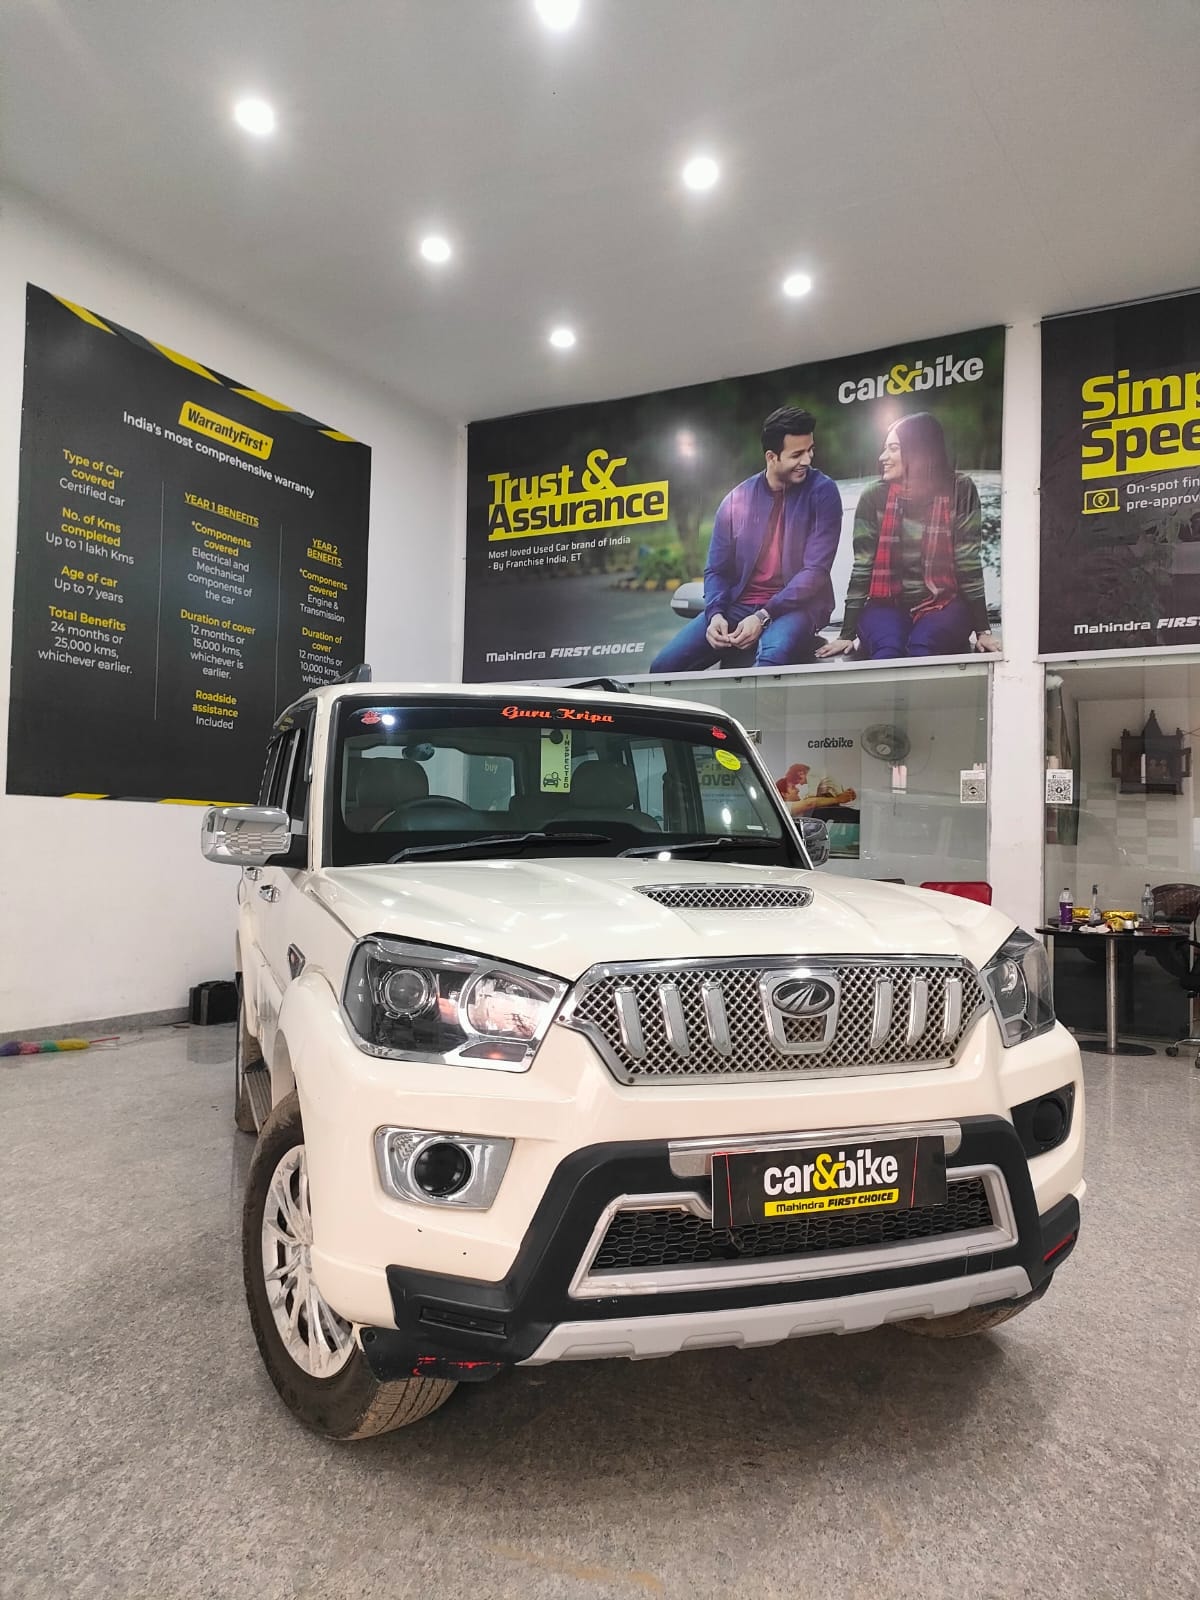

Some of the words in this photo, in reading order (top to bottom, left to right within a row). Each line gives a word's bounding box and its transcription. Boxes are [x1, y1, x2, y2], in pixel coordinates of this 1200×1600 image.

[838, 355, 984, 404] car&bike
[63, 449, 90, 468] Type
[92, 461, 105, 472] of
[105, 464, 125, 479] Car
[123, 411, 162, 436] India's
[164, 429, 193, 449] most
[195, 442, 273, 481] comprehensive
[274, 474, 315, 499] warranty
[71, 468, 115, 490] covered
[488, 465, 574, 505] Trust
[581, 448, 628, 491] &
[1127, 479, 1179, 495] On-spot
[59, 477, 107, 501] Certified
[109, 495, 126, 507] car
[62, 506, 81, 522] No.
[83, 515, 96, 526] of
[97, 518, 121, 533] Kms
[184, 492, 210, 510] YEAR
[217, 504, 260, 528] BENEFITS
[489, 490, 665, 535] Assurance
[61, 523, 121, 547] completed
[45, 531, 63, 547] Up
[65, 538, 77, 549] to
[85, 542, 108, 558] lakh
[111, 550, 135, 565] Kms
[203, 540, 239, 557] covered
[312, 538, 332, 553] YEAR
[333, 545, 338, 555] 2
[488, 550, 508, 560] Most
[510, 547, 532, 557] loved
[533, 544, 554, 554] Used
[555, 543, 569, 552] Car
[571, 539, 596, 550] brand
[598, 537, 608, 547] of
[609, 536, 631, 546] India
[192, 547, 232, 567] Electrical
[233, 560, 250, 573] and
[307, 547, 343, 568] BENEFITS
[493, 561, 504, 571] By
[506, 556, 544, 569] Franchise
[546, 554, 569, 564] India,
[571, 553, 582, 562] ET
[61, 565, 85, 580] Age
[86, 572, 100, 584] of
[100, 577, 118, 588] car
[196, 561, 245, 583] Mechanical
[54, 577, 71, 593] Up
[73, 583, 85, 594] to
[86, 585, 95, 596] 7
[95, 589, 124, 604] years
[187, 573, 242, 595] components
[243, 588, 253, 598] of
[308, 584, 337, 599] covered
[205, 590, 220, 602] the
[221, 595, 235, 605] car
[307, 594, 333, 609] Engine
[333, 601, 339, 610] &
[48, 605, 77, 621] Total
[79, 612, 127, 632] Benefits
[180, 608, 220, 627] Duration
[221, 620, 231, 630] of
[232, 623, 256, 635] cover
[299, 603, 345, 623] Transmission
[50, 621, 65, 634] 24
[67, 626, 110, 642] months
[112, 635, 124, 645] or
[190, 624, 199, 635] 12
[201, 628, 234, 643] months
[236, 636, 245, 645] or
[302, 627, 334, 642] Duration
[335, 636, 343, 644] of
[1074, 621, 1151, 635] Mahindra
[54, 636, 92, 653] 25,000
[94, 643, 119, 659] kms,
[192, 637, 220, 651] 15,000
[222, 644, 242, 658] kms,
[299, 649, 306, 659] 12
[307, 652, 335, 665] months
[311, 642, 332, 653] cover
[486, 650, 546, 663] Mahindra
[550, 646, 591, 659] FIRST
[592, 642, 645, 656] CHOICE
[38, 649, 96, 668] whichever
[97, 660, 133, 674] earlier.
[190, 651, 235, 667] whichever
[237, 659, 244, 670] is
[300, 661, 323, 674] 10,000
[203, 667, 232, 680] earlier.
[302, 674, 330, 686] whiche
[195, 690, 237, 705] Roadside
[192, 703, 239, 717] assistance
[501, 706, 552, 719] Guru
[556, 708, 615, 723] Kripa
[196, 715, 234, 730] Included
[808, 736, 853, 749] car&bike
[484, 760, 498, 775] buy
[701, 774, 736, 787] over
[763, 1149, 899, 1196] car&bike
[776, 1201, 825, 1213] Mahindra
[827, 1196, 858, 1208] FIRST
[858, 1191, 894, 1204] CHOICE
